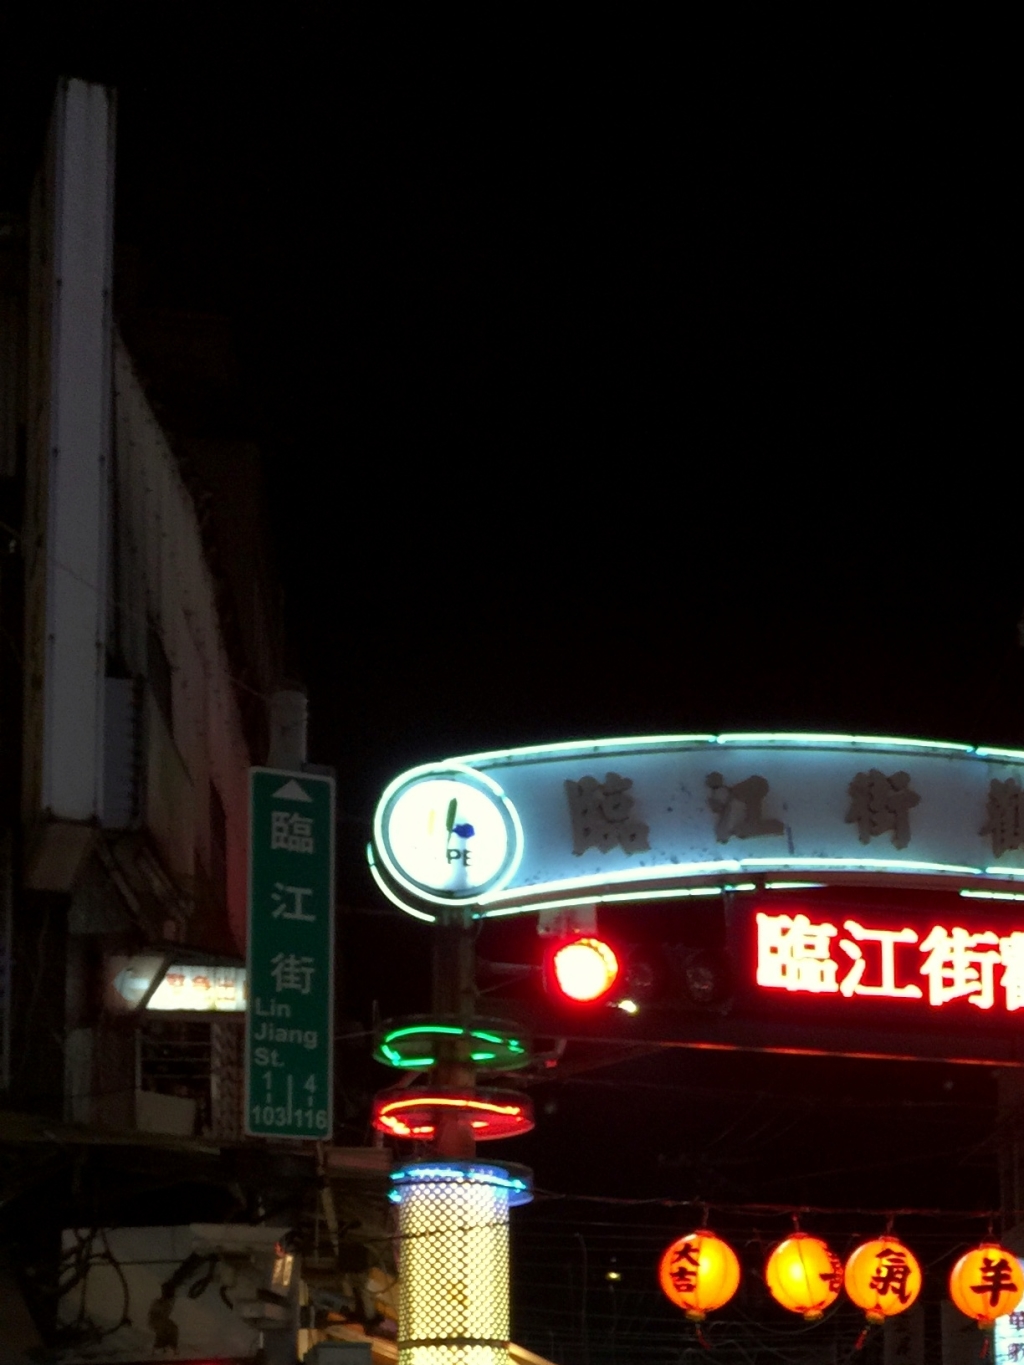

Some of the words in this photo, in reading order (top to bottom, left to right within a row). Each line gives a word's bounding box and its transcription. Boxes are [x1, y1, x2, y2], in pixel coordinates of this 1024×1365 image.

[270, 811, 317, 996] 臨江街
[255, 997, 291, 1018] Lin
[255, 1022, 319, 1051] Jiang
[669, 1242, 701, 1294] 大吉
[969, 1256, 1019, 1308] 羊
